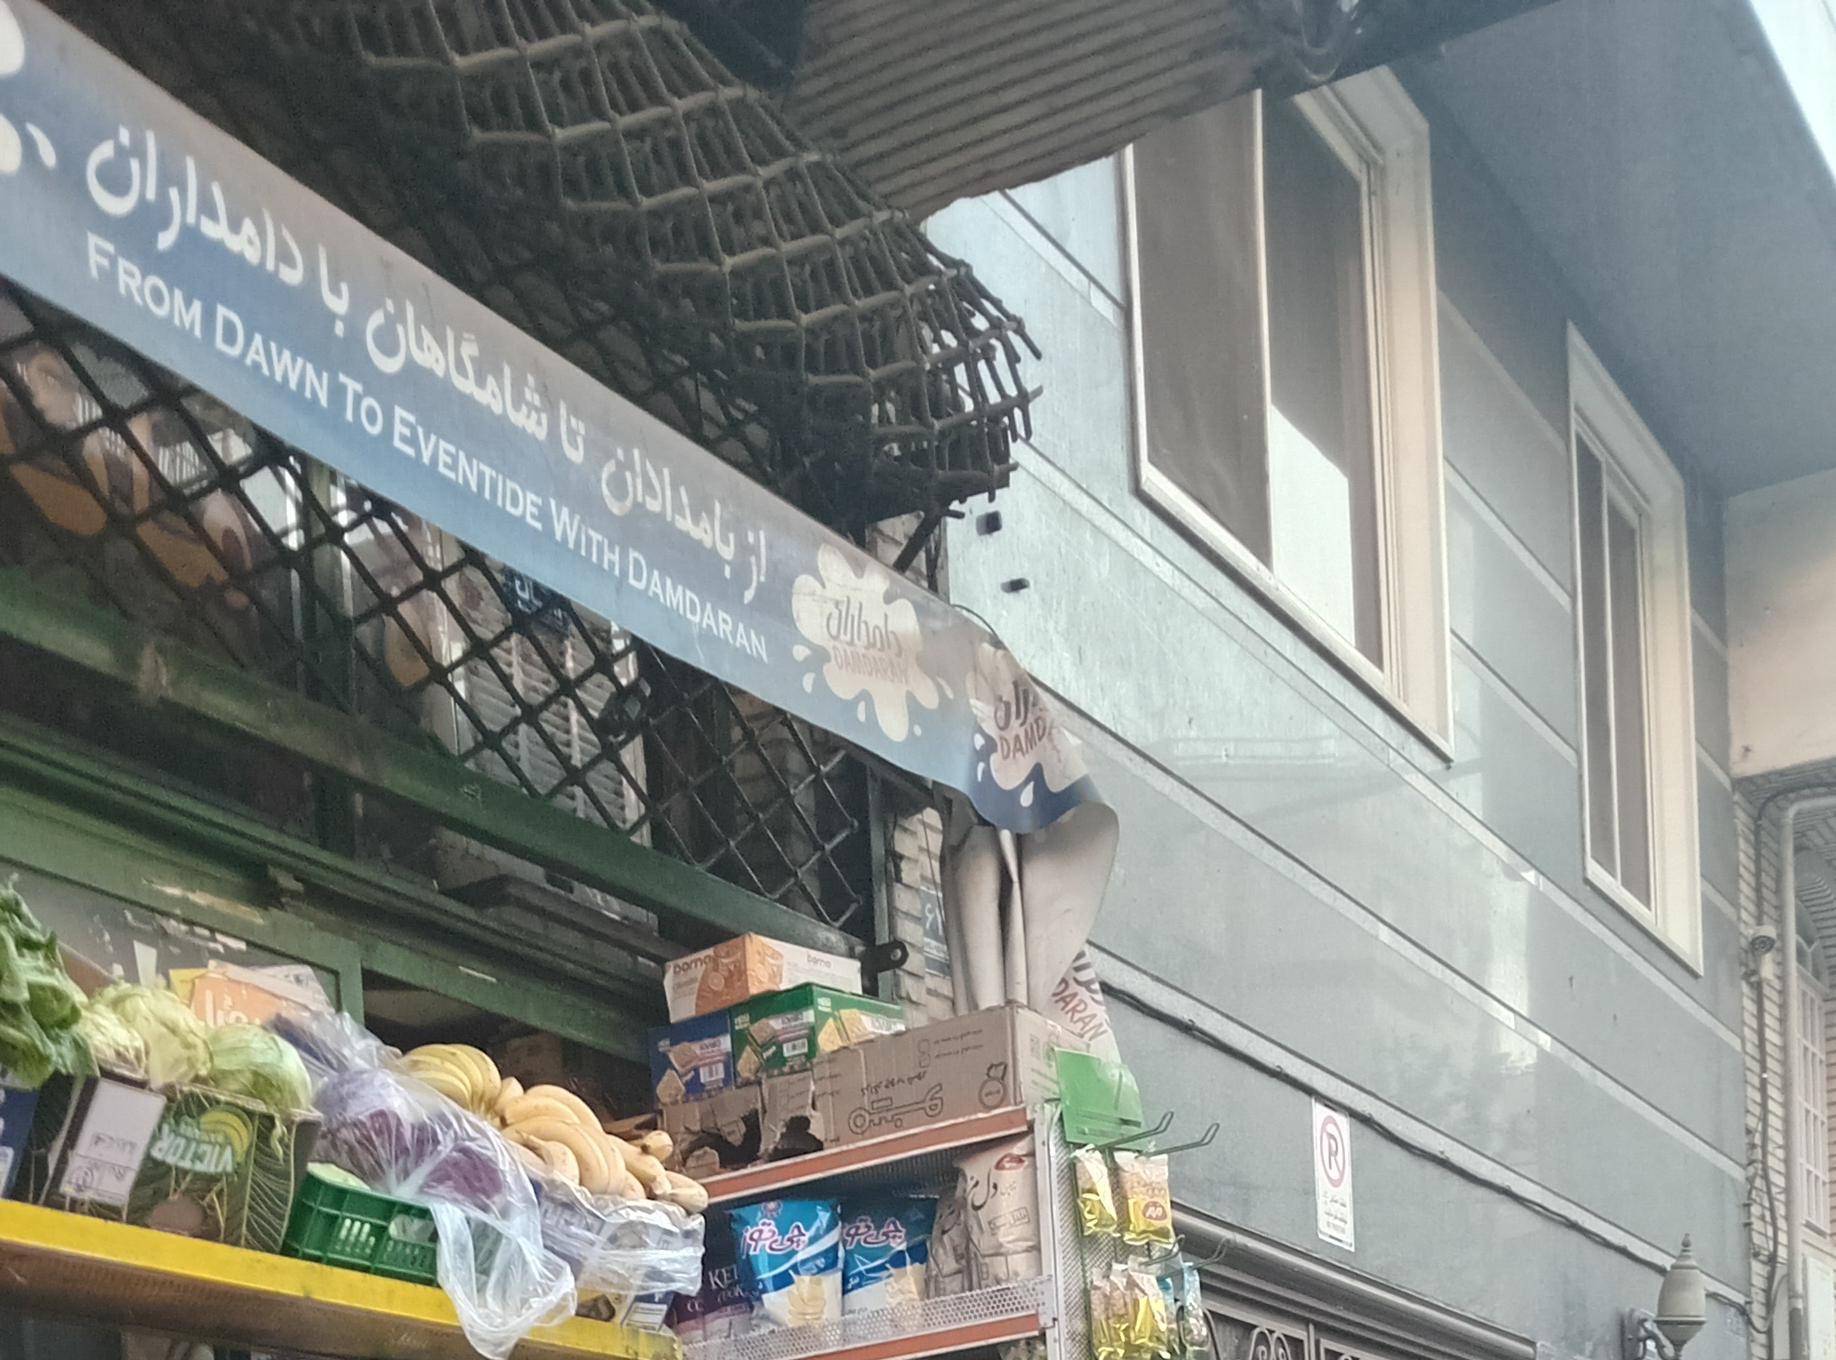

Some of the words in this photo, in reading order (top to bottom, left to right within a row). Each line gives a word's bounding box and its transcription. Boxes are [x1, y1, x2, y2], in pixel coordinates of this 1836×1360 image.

[85, 124, 305, 287] دامداران
[318, 243, 351, 338] با
[365, 298, 549, 443] شامگاهان
[559, 400, 586, 466] تا
[601, 446, 736, 573] بامدادان
[628, 551, 769, 665] DAMDARAN
[743, 529, 767, 604] از
[833, 646, 911, 686] DAMDARAN
[148, 1122, 234, 1174] VICTOR
